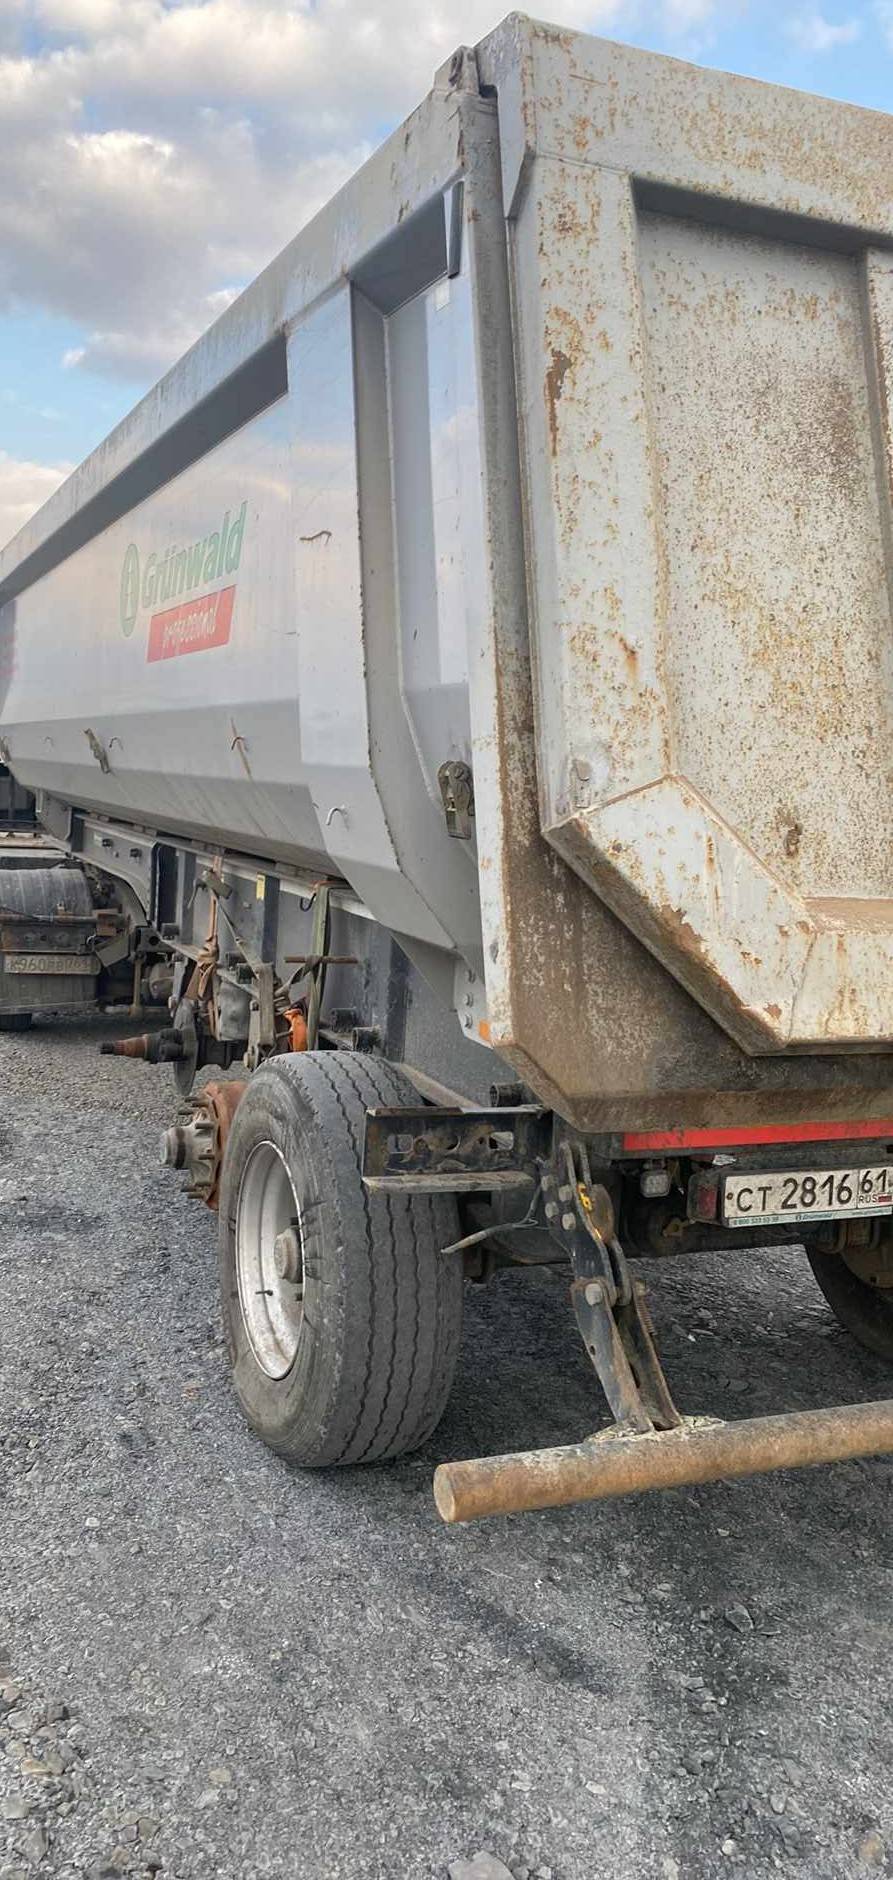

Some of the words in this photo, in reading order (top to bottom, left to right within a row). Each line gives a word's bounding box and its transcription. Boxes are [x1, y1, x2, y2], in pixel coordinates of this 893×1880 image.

[142, 500, 247, 608] Grünwald
[781, 1173, 852, 1209] 2816
[861, 1169, 887, 1194] 61
[859, 1195, 877, 1203] RUS
